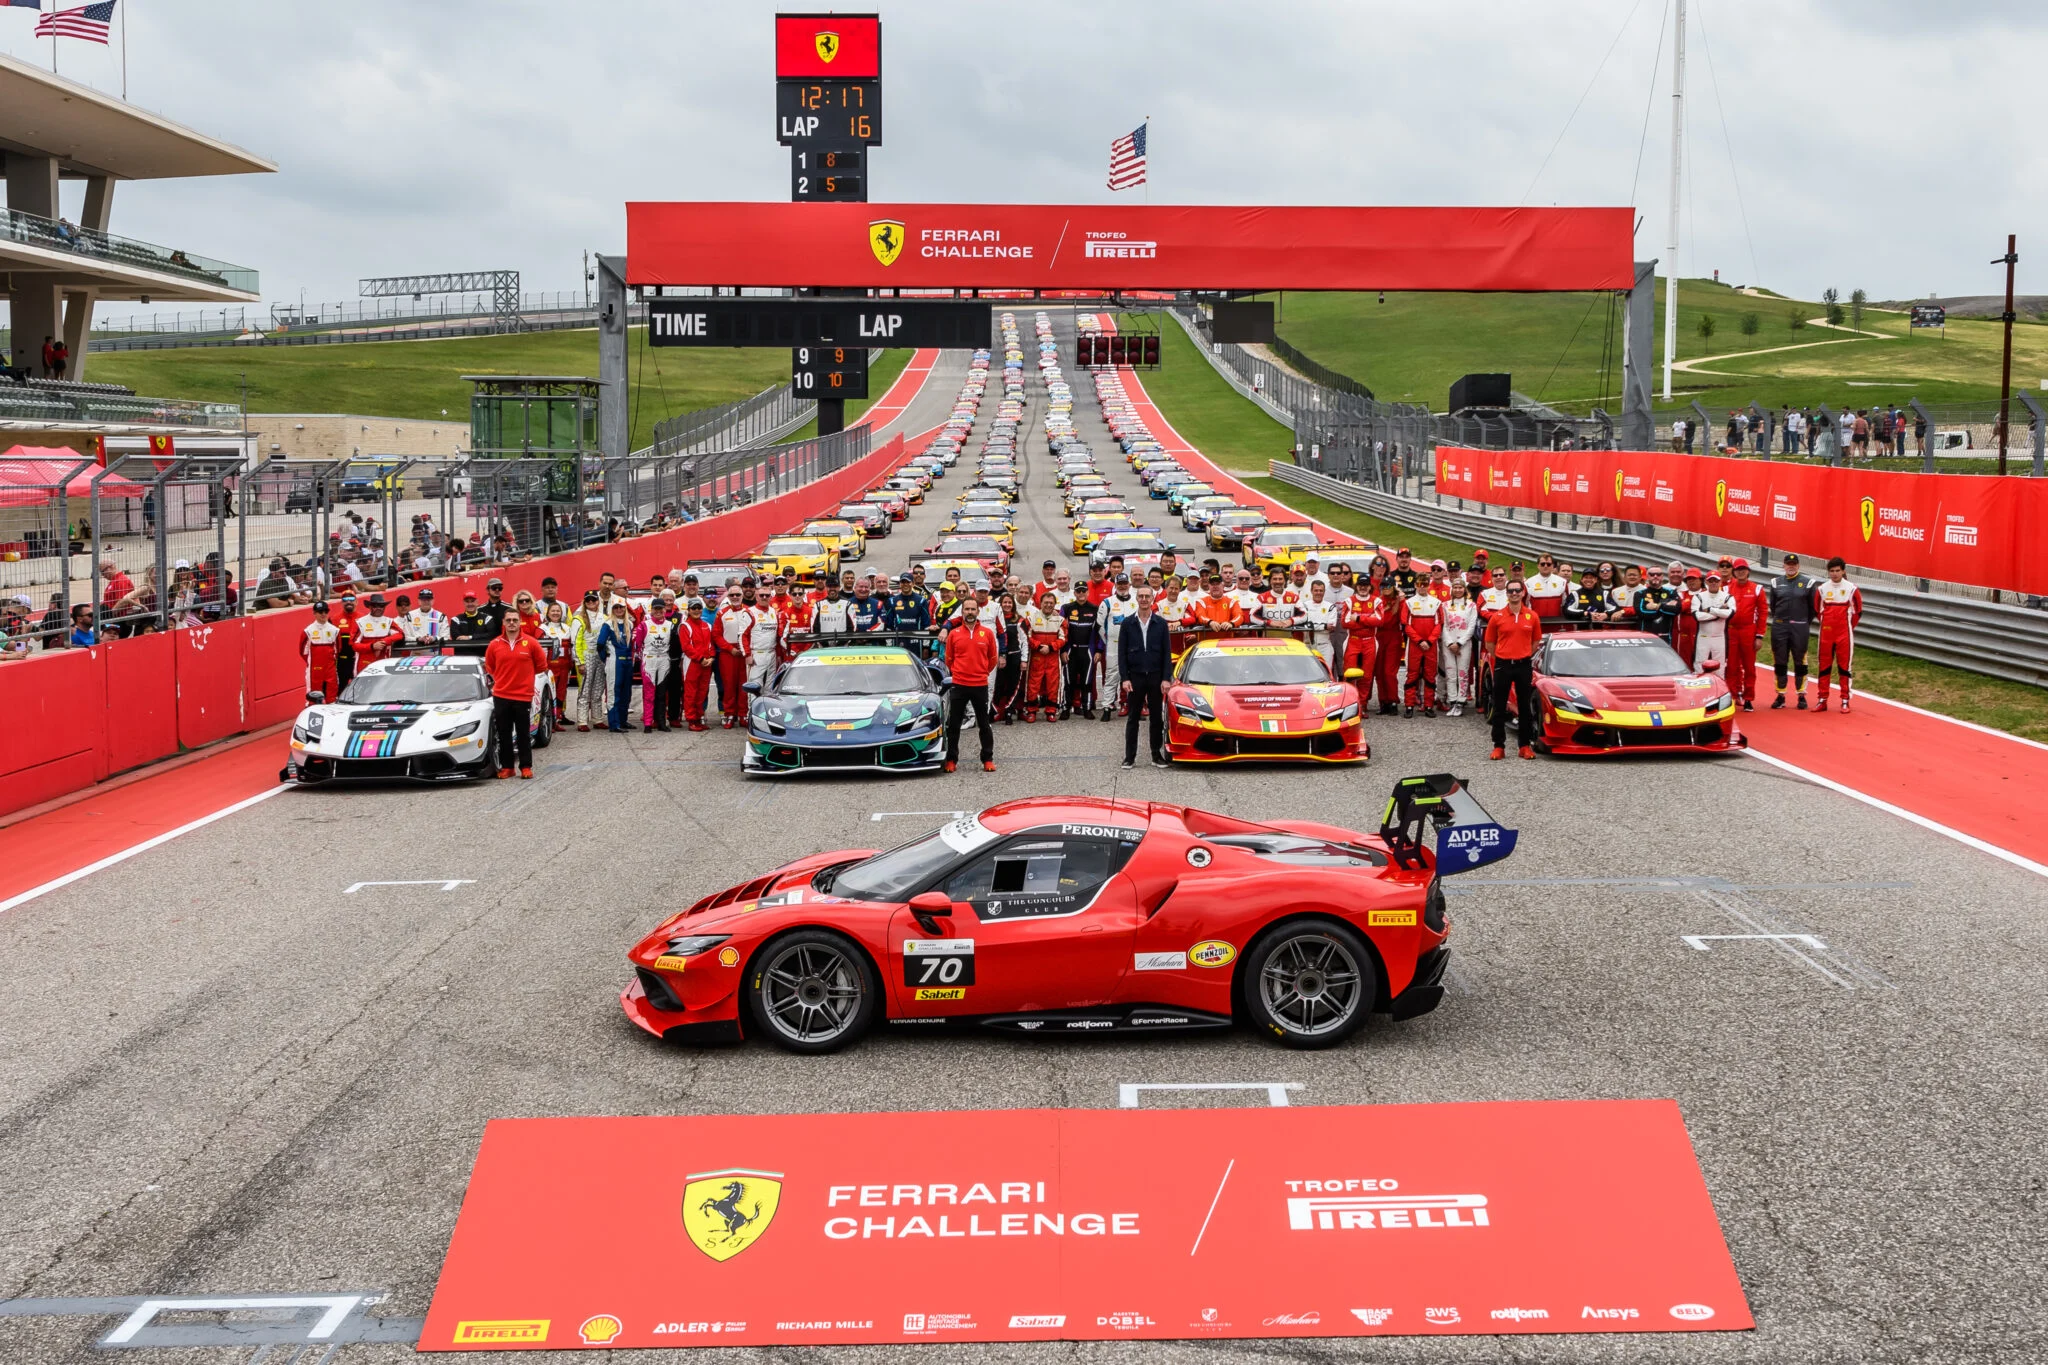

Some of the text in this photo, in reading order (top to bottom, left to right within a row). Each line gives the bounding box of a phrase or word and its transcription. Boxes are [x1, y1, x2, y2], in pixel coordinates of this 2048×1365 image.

[801, 86, 863, 109] 12:17
[782, 115, 871, 138] LAP 16
[798, 152, 835, 169] 1 8
[798, 177, 835, 194] 2 5
[921, 229, 1000, 242] FERRARI
[1085, 231, 1127, 239] TROFEO
[921, 246, 1034, 258] CHALLENGE
[1085, 241, 1157, 258] PIRELLI
[652, 313, 707, 336] TIME
[859, 314, 902, 337] LAP
[799, 348, 844, 365] 9 9
[793, 372, 842, 389] 10 10
[1624, 476, 1641, 486] FERRARI
[1623, 489, 1646, 499] CHALLENGE
[1728, 488, 1752, 500] FERRARI
[1728, 502, 1760, 516] CHALLENGE
[1774, 503, 1796, 521] PIRELLI
[1879, 507, 1911, 522] FERRARI
[1946, 514, 1964, 523] TROFEO
[1879, 524, 1924, 541] CHALLENGE
[1945, 524, 1978, 546] PIRELLI
[1266, 610, 1292, 619] octa
[1062, 824, 1120, 838] PERONI
[1448, 829, 1499, 842] ADLER
[1027, 895, 1076, 905] CONCOURS
[1372, 914, 1412, 922] PIRELLI
[1195, 946, 1230, 961] PENNZOIL
[657, 958, 683, 969] PIRELLI
[918, 958, 963, 983] 70
[920, 990, 960, 999] Sabelt
[1066, 1020, 1113, 1029] rotiform
[1131, 1017, 1188, 1025] @FerrariRaces
[1285, 1179, 1399, 1192] TROFEO
[828, 1182, 1045, 1207] FERRARI
[1287, 1194, 1490, 1230] PIRELLI
[823, 1212, 1140, 1239] CHALLENGE
[1425, 1307, 1459, 1317] aws
[1490, 1307, 1550, 1322] rotiform
[1581, 1306, 1641, 1320] Ansys
[653, 1322, 709, 1334] ADLER
[776, 1320, 874, 1330] RICHARD MILLE
[1016, 1317, 1058, 1326] Sabelt
[1097, 1316, 1156, 1326] DOBEL
[462, 1324, 541, 1338] PIRELLI
